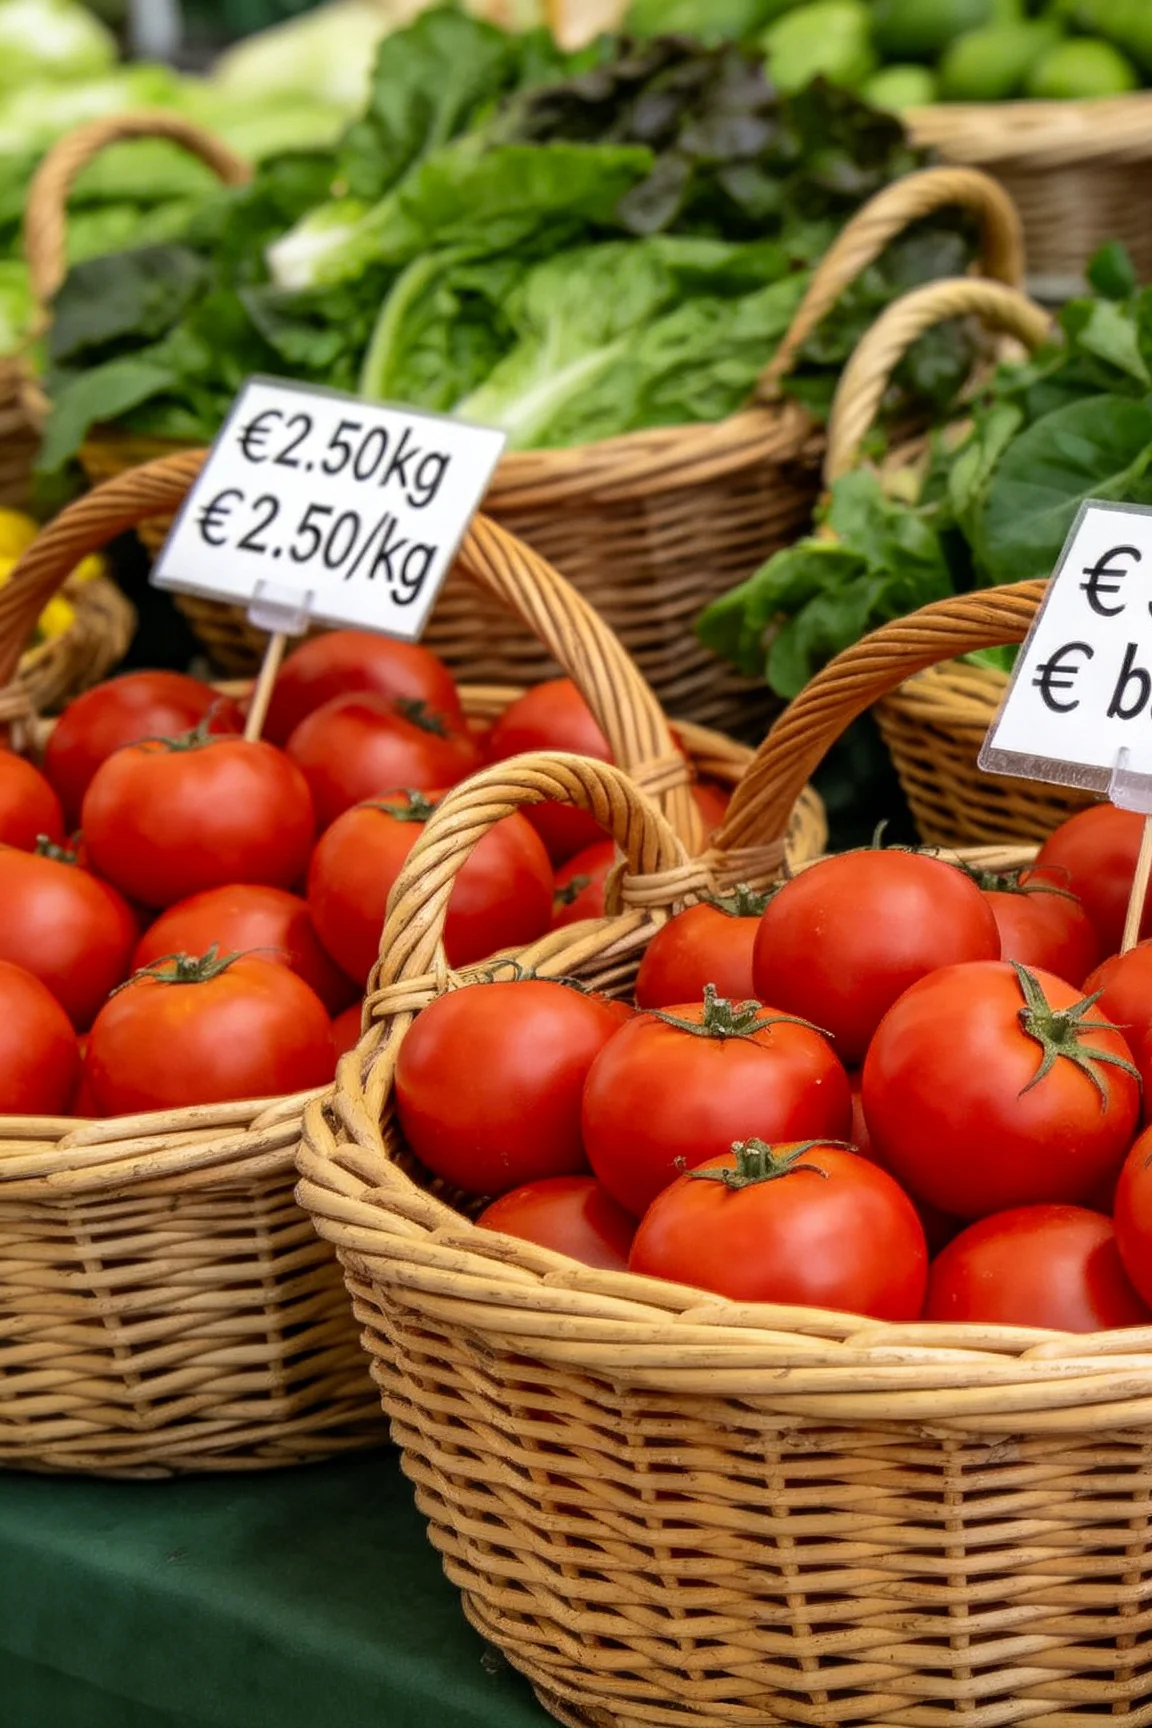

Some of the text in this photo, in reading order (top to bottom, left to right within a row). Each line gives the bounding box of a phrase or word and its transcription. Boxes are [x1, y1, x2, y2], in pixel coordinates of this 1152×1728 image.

[237, 409, 451, 508] €2.50kg
[196, 489, 438, 606] €2.50/kg
[1031, 642, 1094, 713] €
